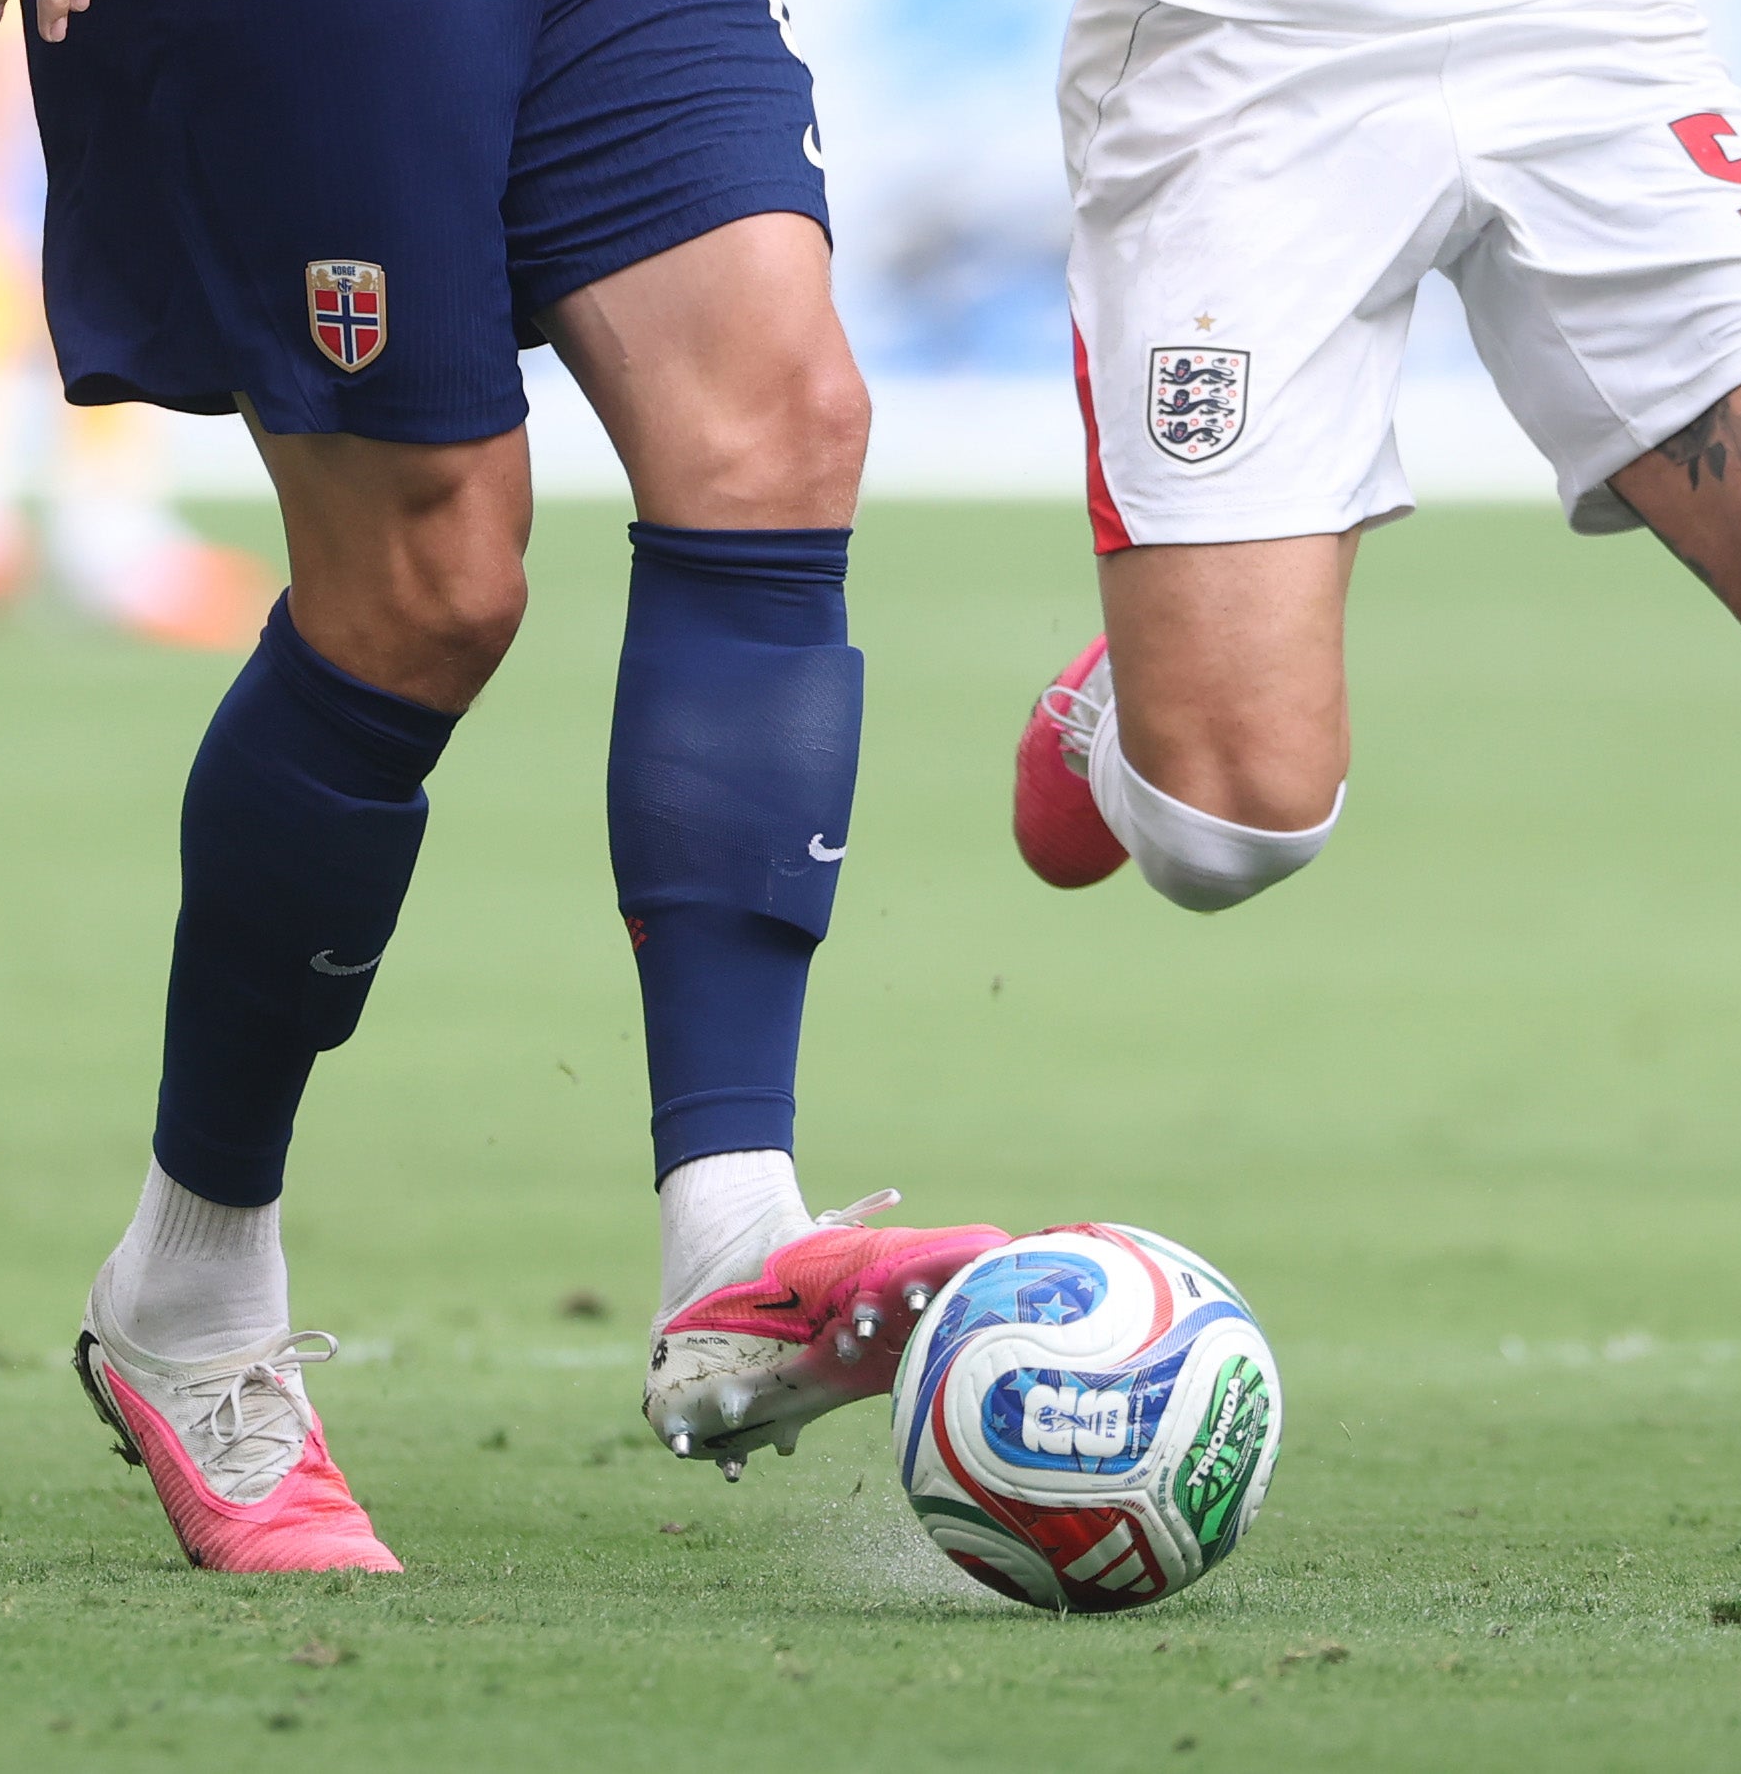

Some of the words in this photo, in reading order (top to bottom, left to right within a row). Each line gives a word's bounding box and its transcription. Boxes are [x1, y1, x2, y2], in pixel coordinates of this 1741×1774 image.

[331, 265, 357, 277] NORGE
[1105, 1408, 1119, 1439] FIFA
[1186, 1377, 1244, 1488] TRIONDA
